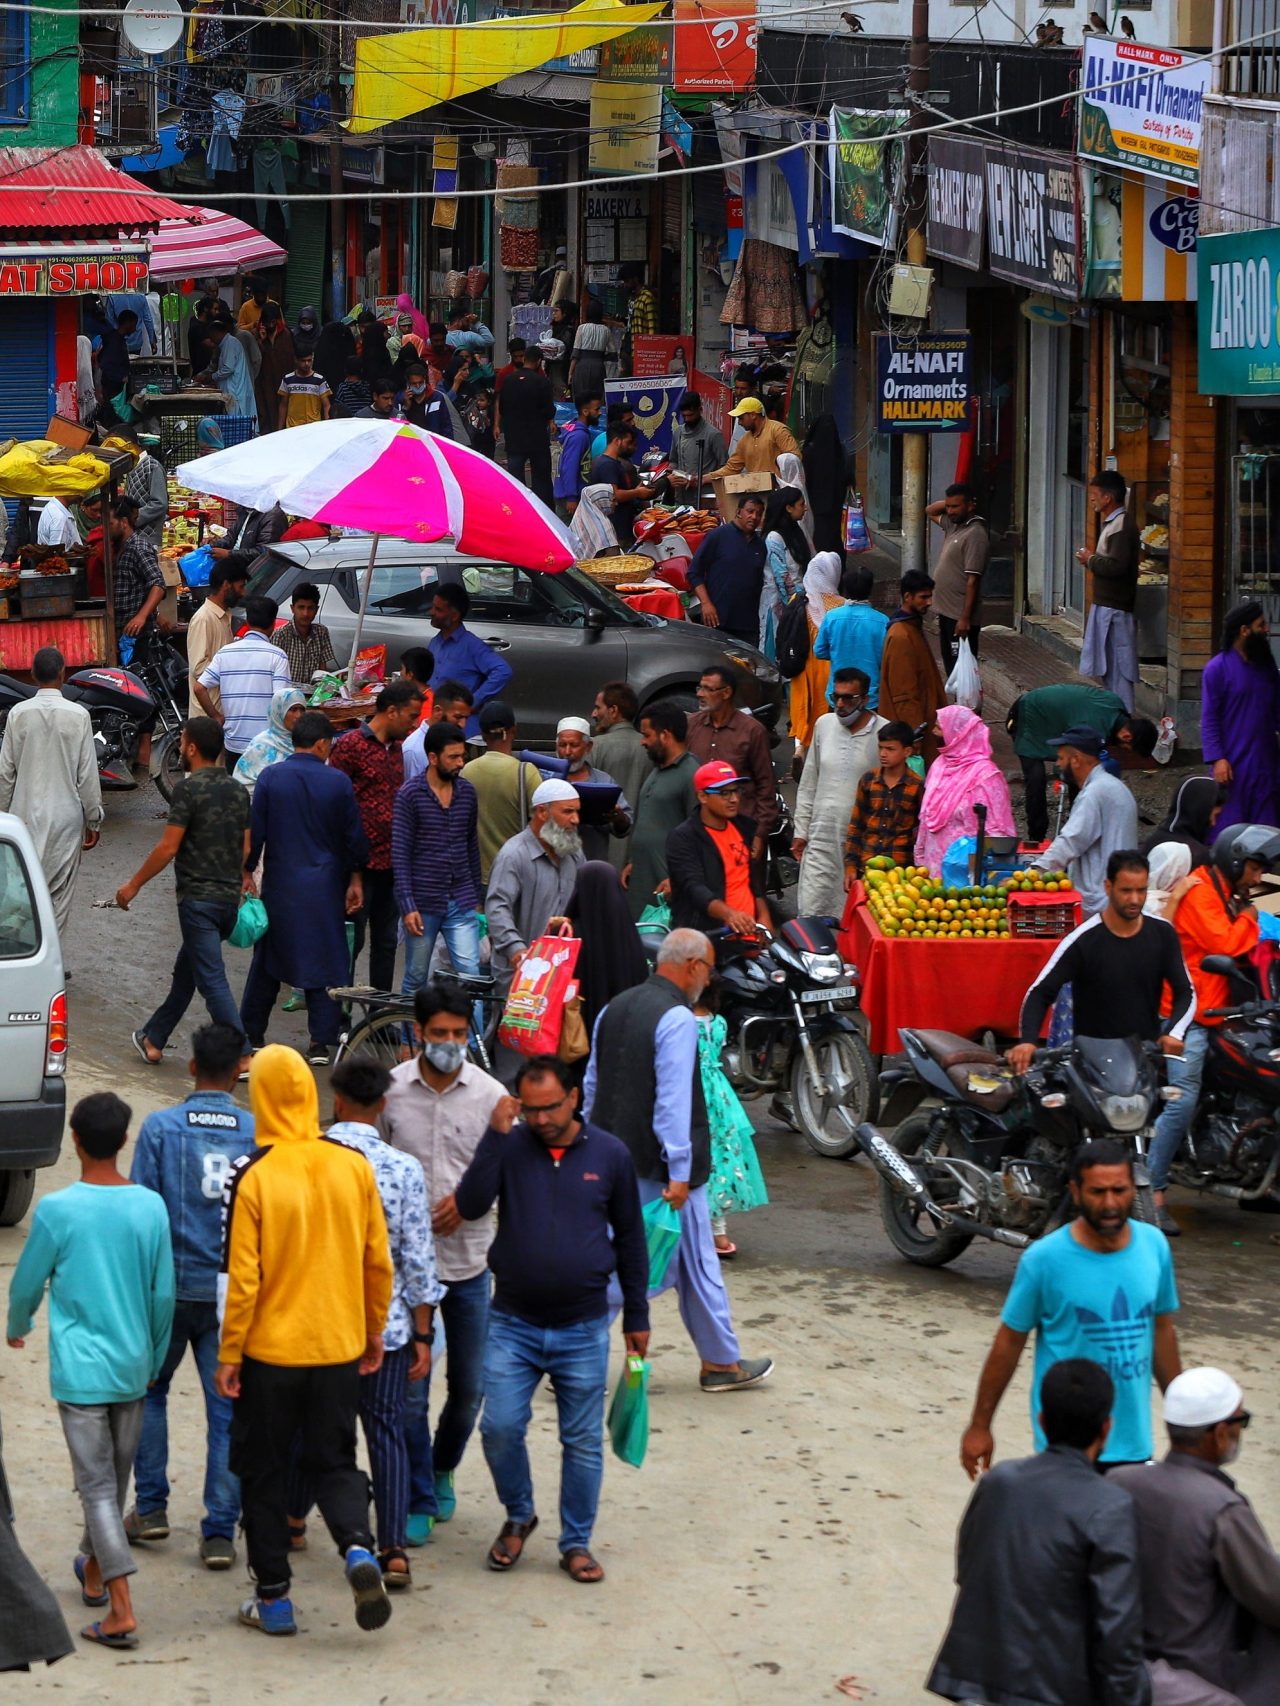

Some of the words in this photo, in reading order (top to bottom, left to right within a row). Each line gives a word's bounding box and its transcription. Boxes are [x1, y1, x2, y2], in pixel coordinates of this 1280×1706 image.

[1159, 54, 1179, 65] ONLY
[714, 78, 734, 86] Partner
[1085, 56, 1154, 113] AL-NAFI
[587, 199, 631, 217] BAKERY
[987, 162, 1014, 260] NEW
[49, 261, 150, 293] SHOP
[1210, 256, 1271, 350] ZAROO
[887, 352, 965, 374] AL-NAFI
[883, 377, 968, 399] Ornaments
[882, 400, 967, 420] HALLMARK
[8, 1012, 41, 1022] EECO
[200, 1152, 231, 1199] 8
